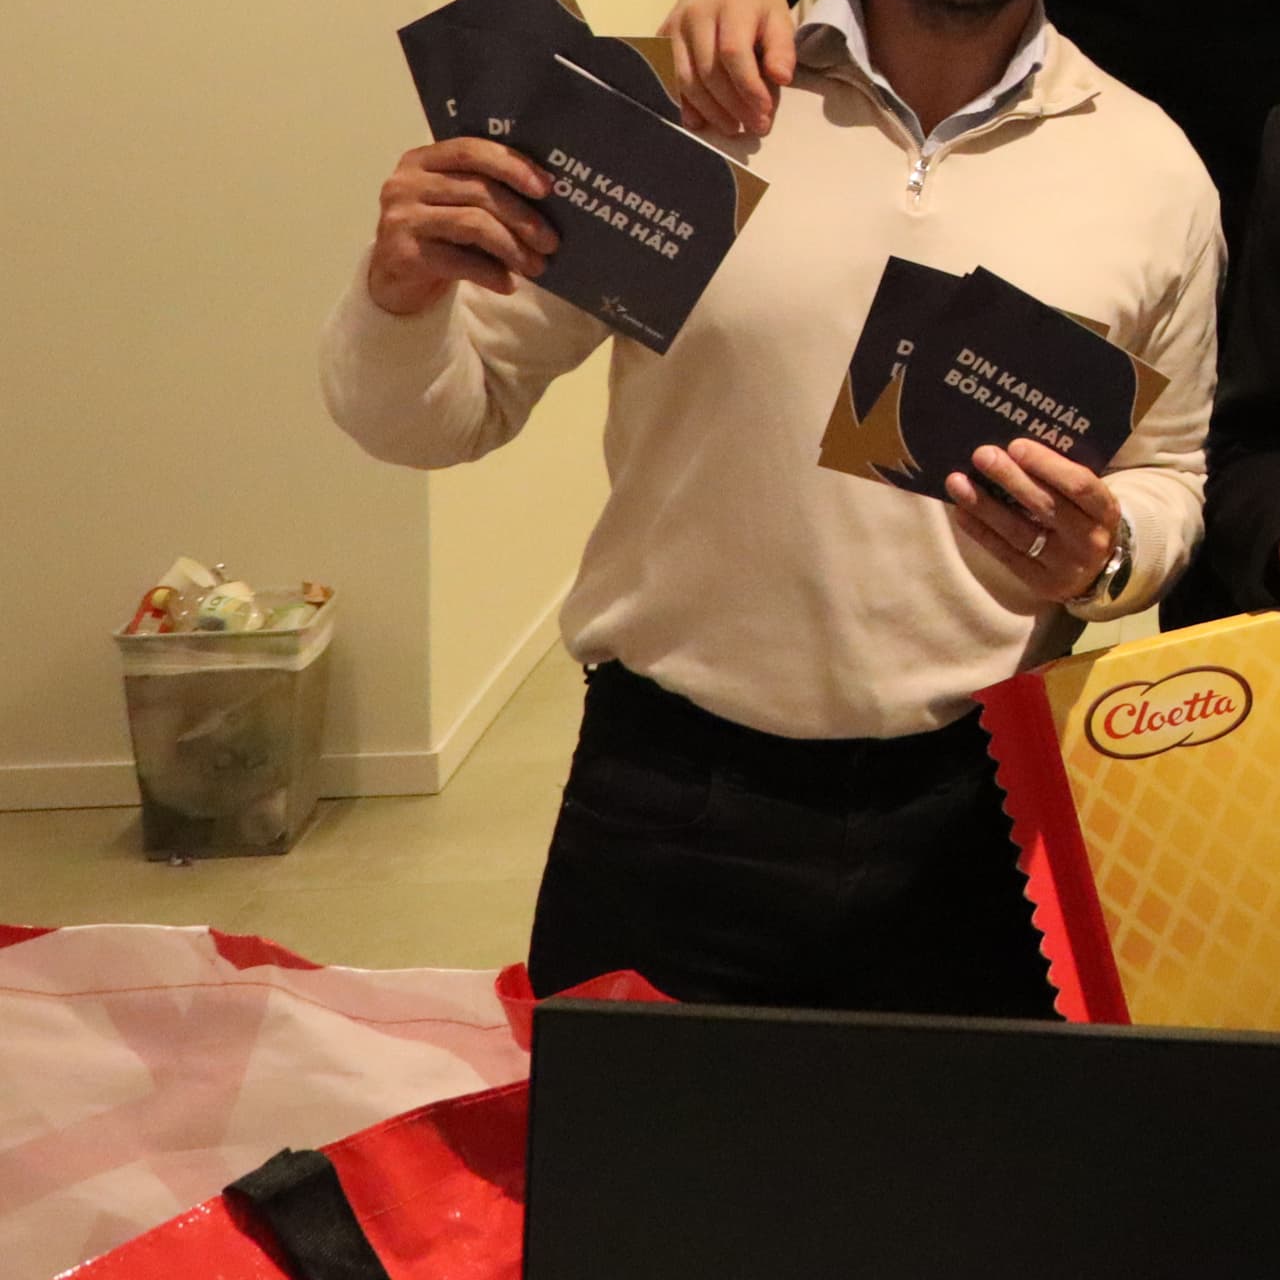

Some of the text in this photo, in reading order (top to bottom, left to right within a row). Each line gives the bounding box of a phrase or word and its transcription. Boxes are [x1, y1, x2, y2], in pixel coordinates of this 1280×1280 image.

[548, 149, 695, 241] DIN KARRIÄR
[630, 222, 681, 260] HÄR
[944, 369, 1029, 426] BÖRJAR
[1028, 419, 1075, 453] HÄR
[956, 348, 1091, 435] DIN KARRIÄR
[1103, 690, 1237, 740] Cloetta
